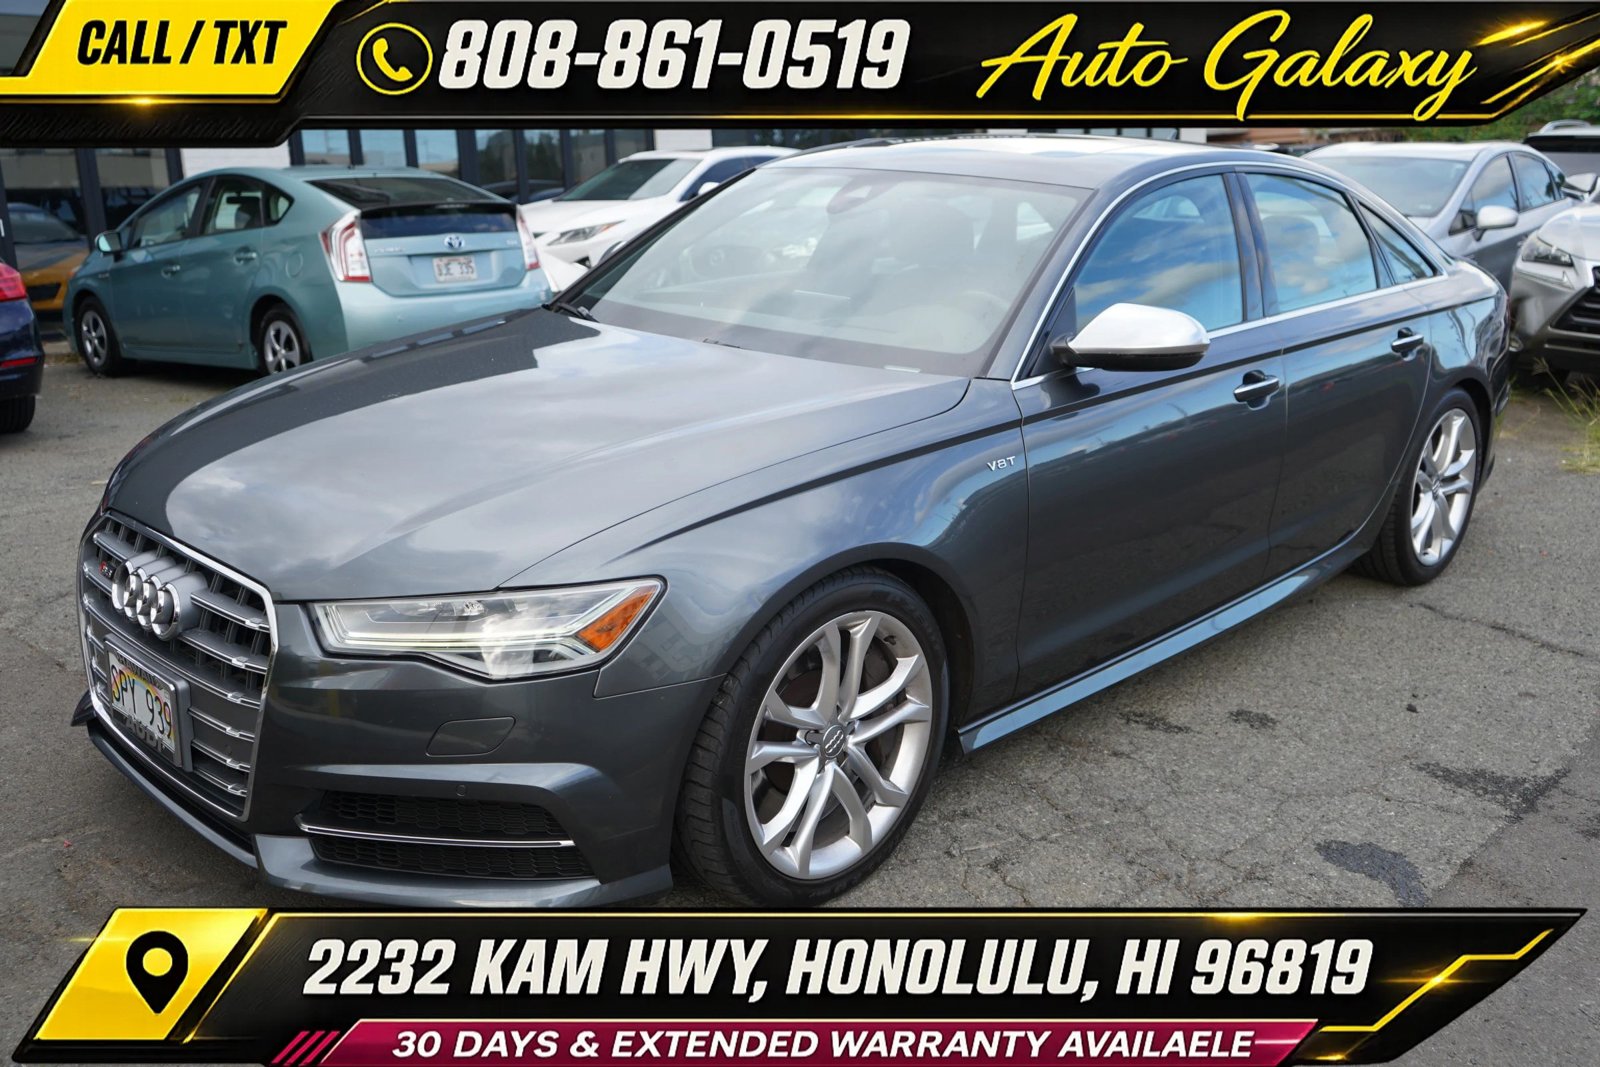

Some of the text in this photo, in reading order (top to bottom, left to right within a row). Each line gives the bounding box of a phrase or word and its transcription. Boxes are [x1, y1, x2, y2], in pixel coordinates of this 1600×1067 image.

[987, 456, 1016, 472] V8T
[110, 664, 137, 715] SPY
[145, 688, 172, 740] 939
